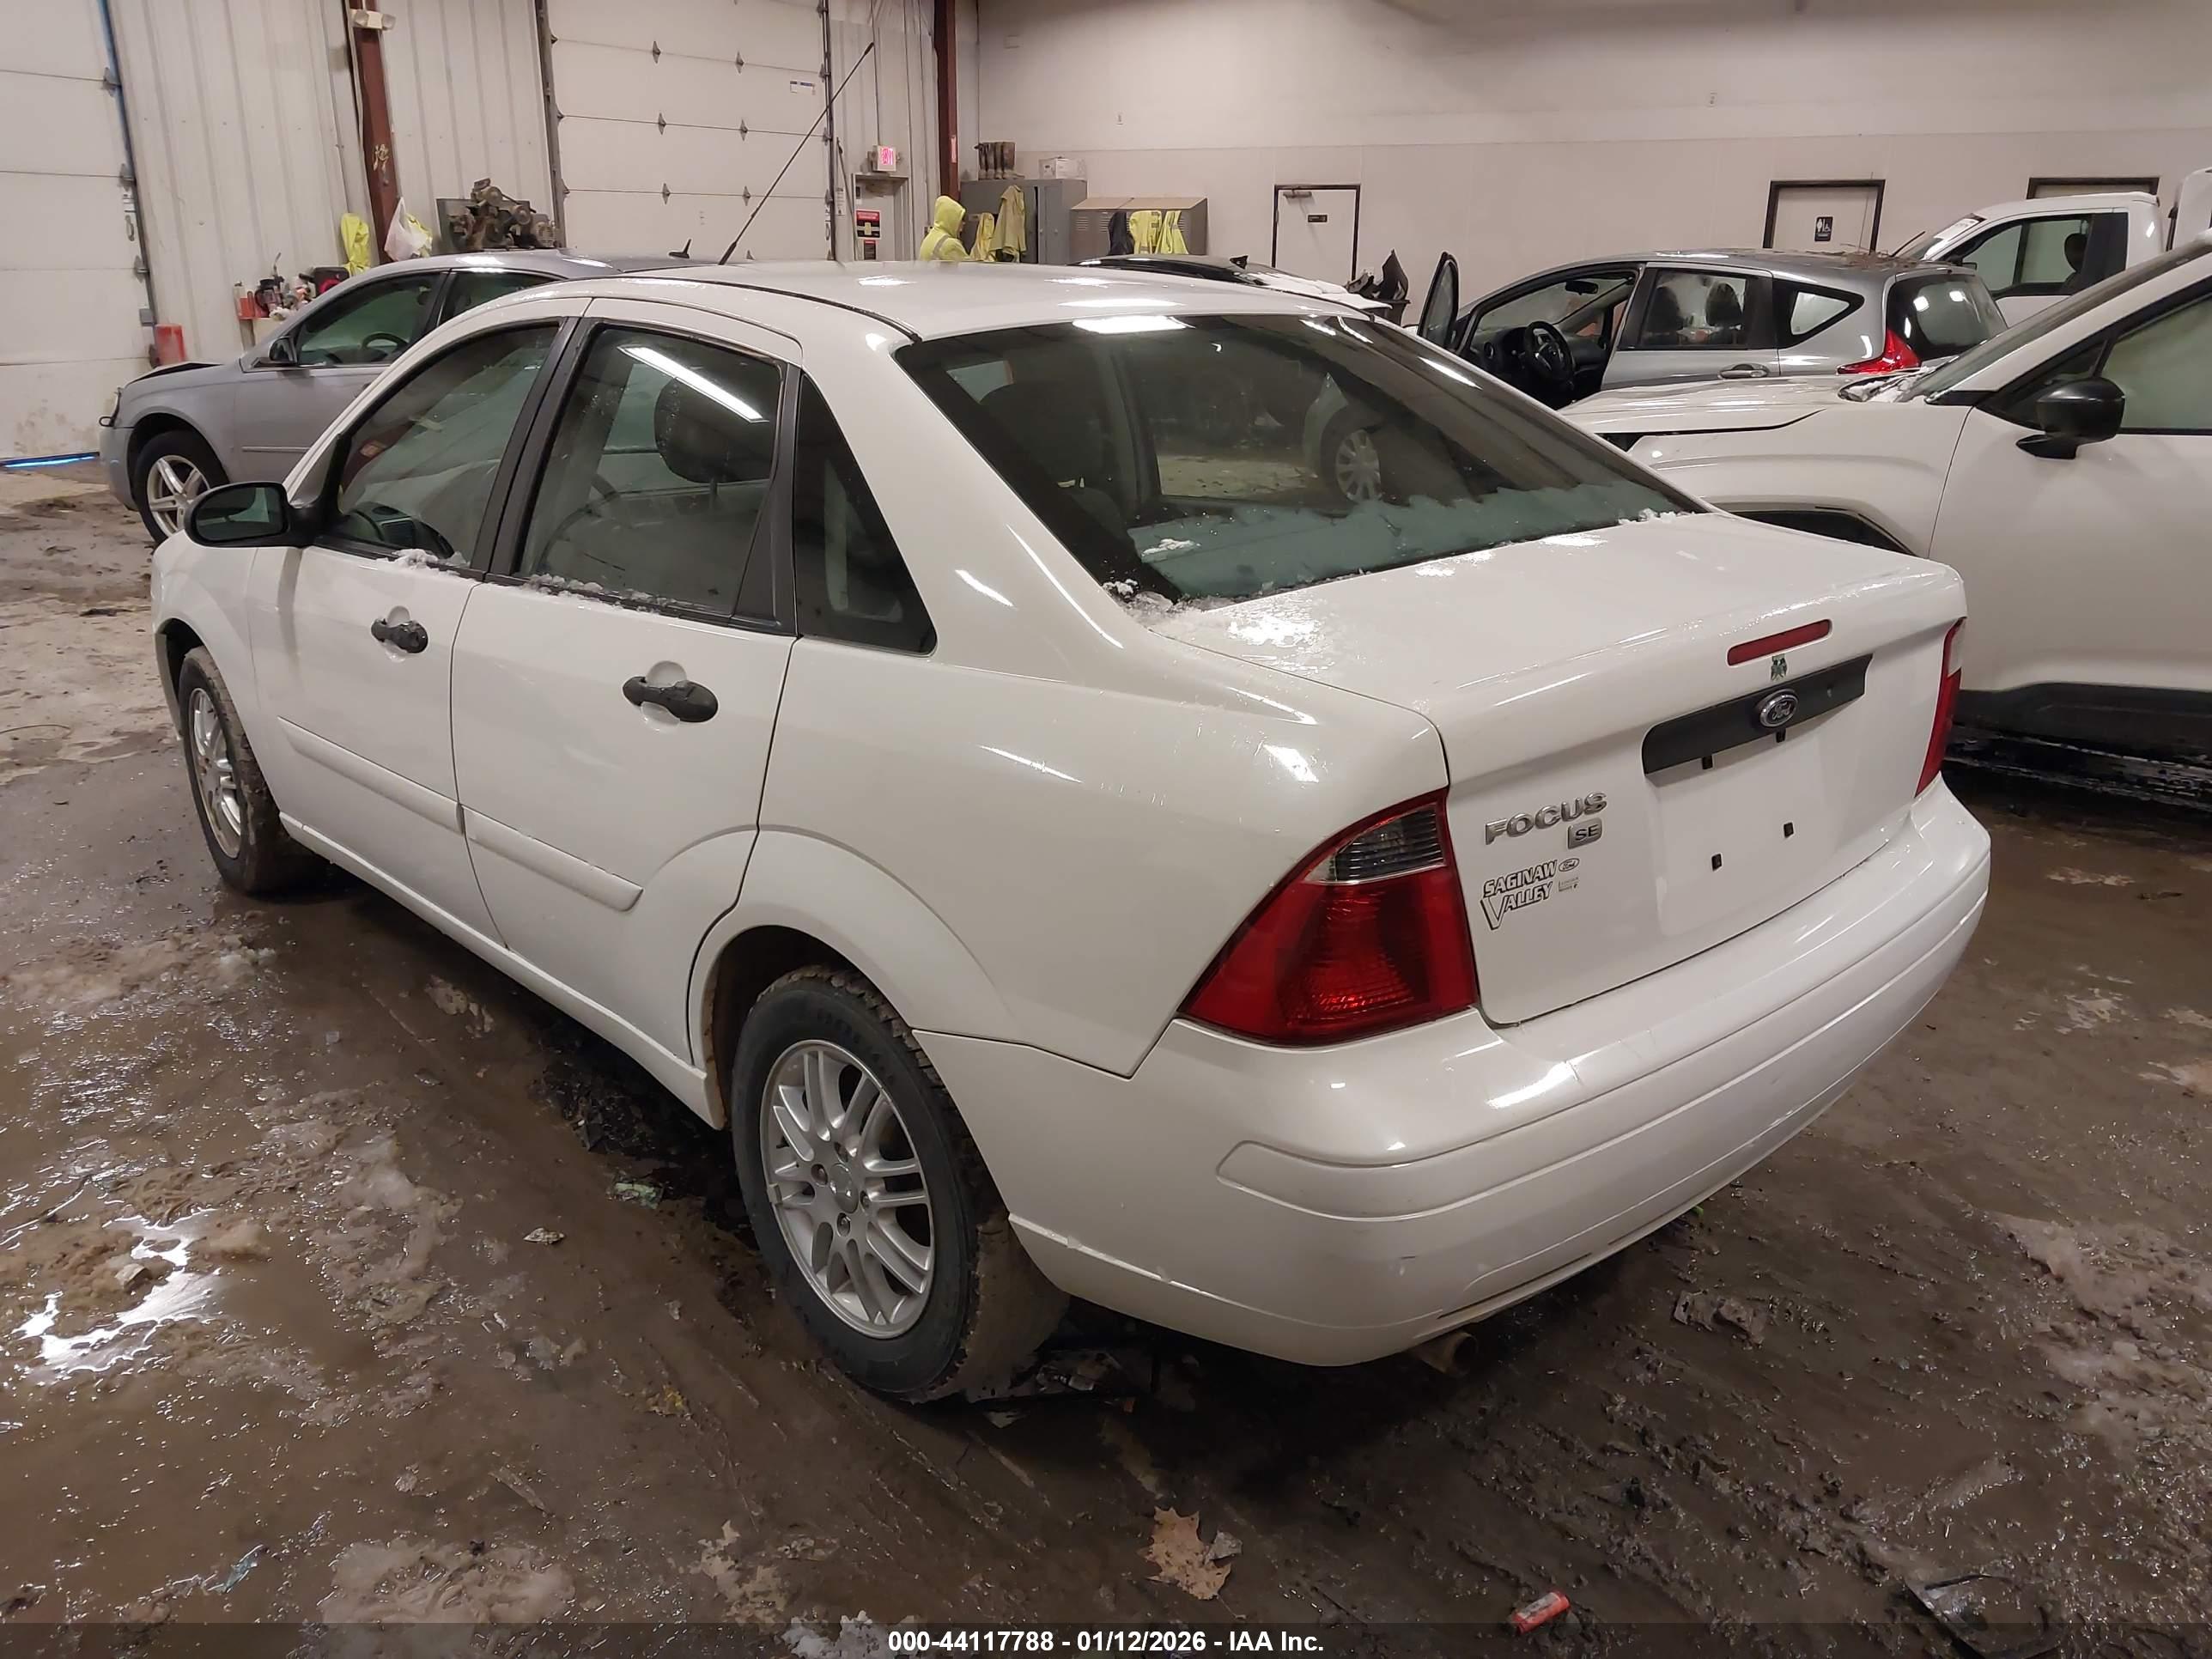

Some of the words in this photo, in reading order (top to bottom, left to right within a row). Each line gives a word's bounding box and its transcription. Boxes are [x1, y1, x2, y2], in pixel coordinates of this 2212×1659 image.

[1485, 792, 1607, 845] FOCUS
[1575, 823, 1600, 842] SE
[1483, 859, 1558, 897] SAGINAW
[1480, 881, 1553, 931] VALLEY
